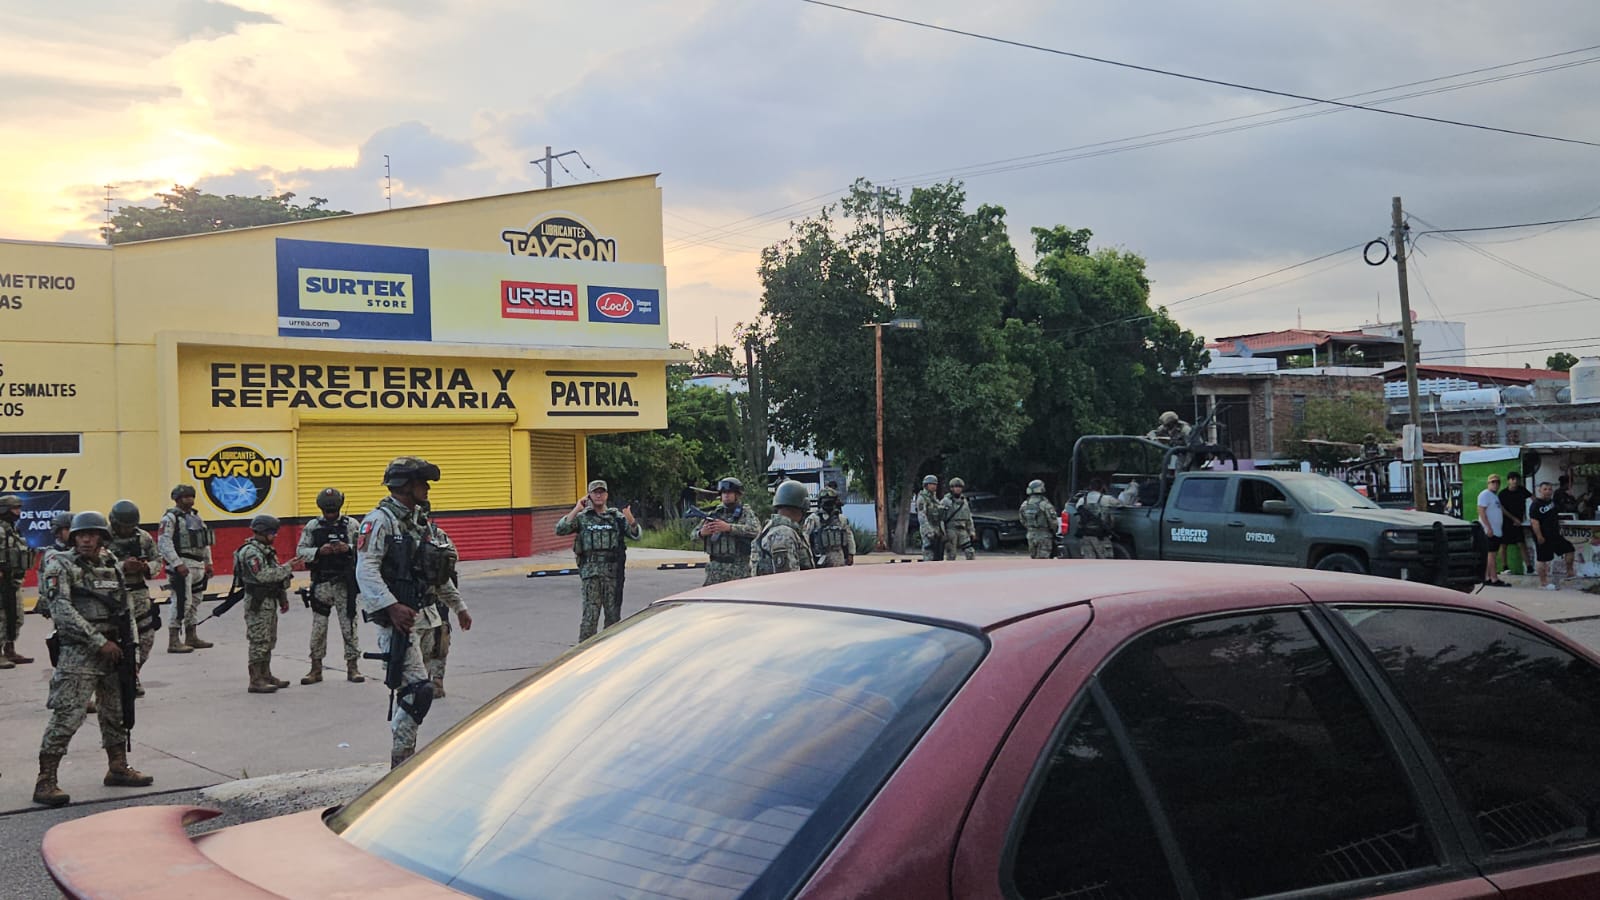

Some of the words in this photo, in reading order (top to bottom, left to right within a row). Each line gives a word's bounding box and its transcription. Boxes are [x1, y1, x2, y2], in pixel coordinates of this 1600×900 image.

[541, 223, 586, 238] LUBRICANTES
[503, 232, 615, 262] TAYRON
[306, 276, 406, 297] SURTEK
[367, 299, 407, 308] STORE
[507, 286, 574, 308] URREA
[601, 297, 630, 312] Lock
[289, 319, 330, 328] urrea.com
[211, 363, 474, 390] FERRETERIA
[492, 369, 516, 391] Y
[9, 383, 77, 397] ESMALTES
[551, 381, 639, 407] PATRIA.
[211, 389, 516, 409] REFACCIONARIA
[187, 459, 282, 479] TAYRON
[20, 511, 34, 519] DE
[35, 510, 67, 519] VENT
[29, 520, 52, 530] AQU
[1171, 527, 1208, 537] EJÉRCITO
